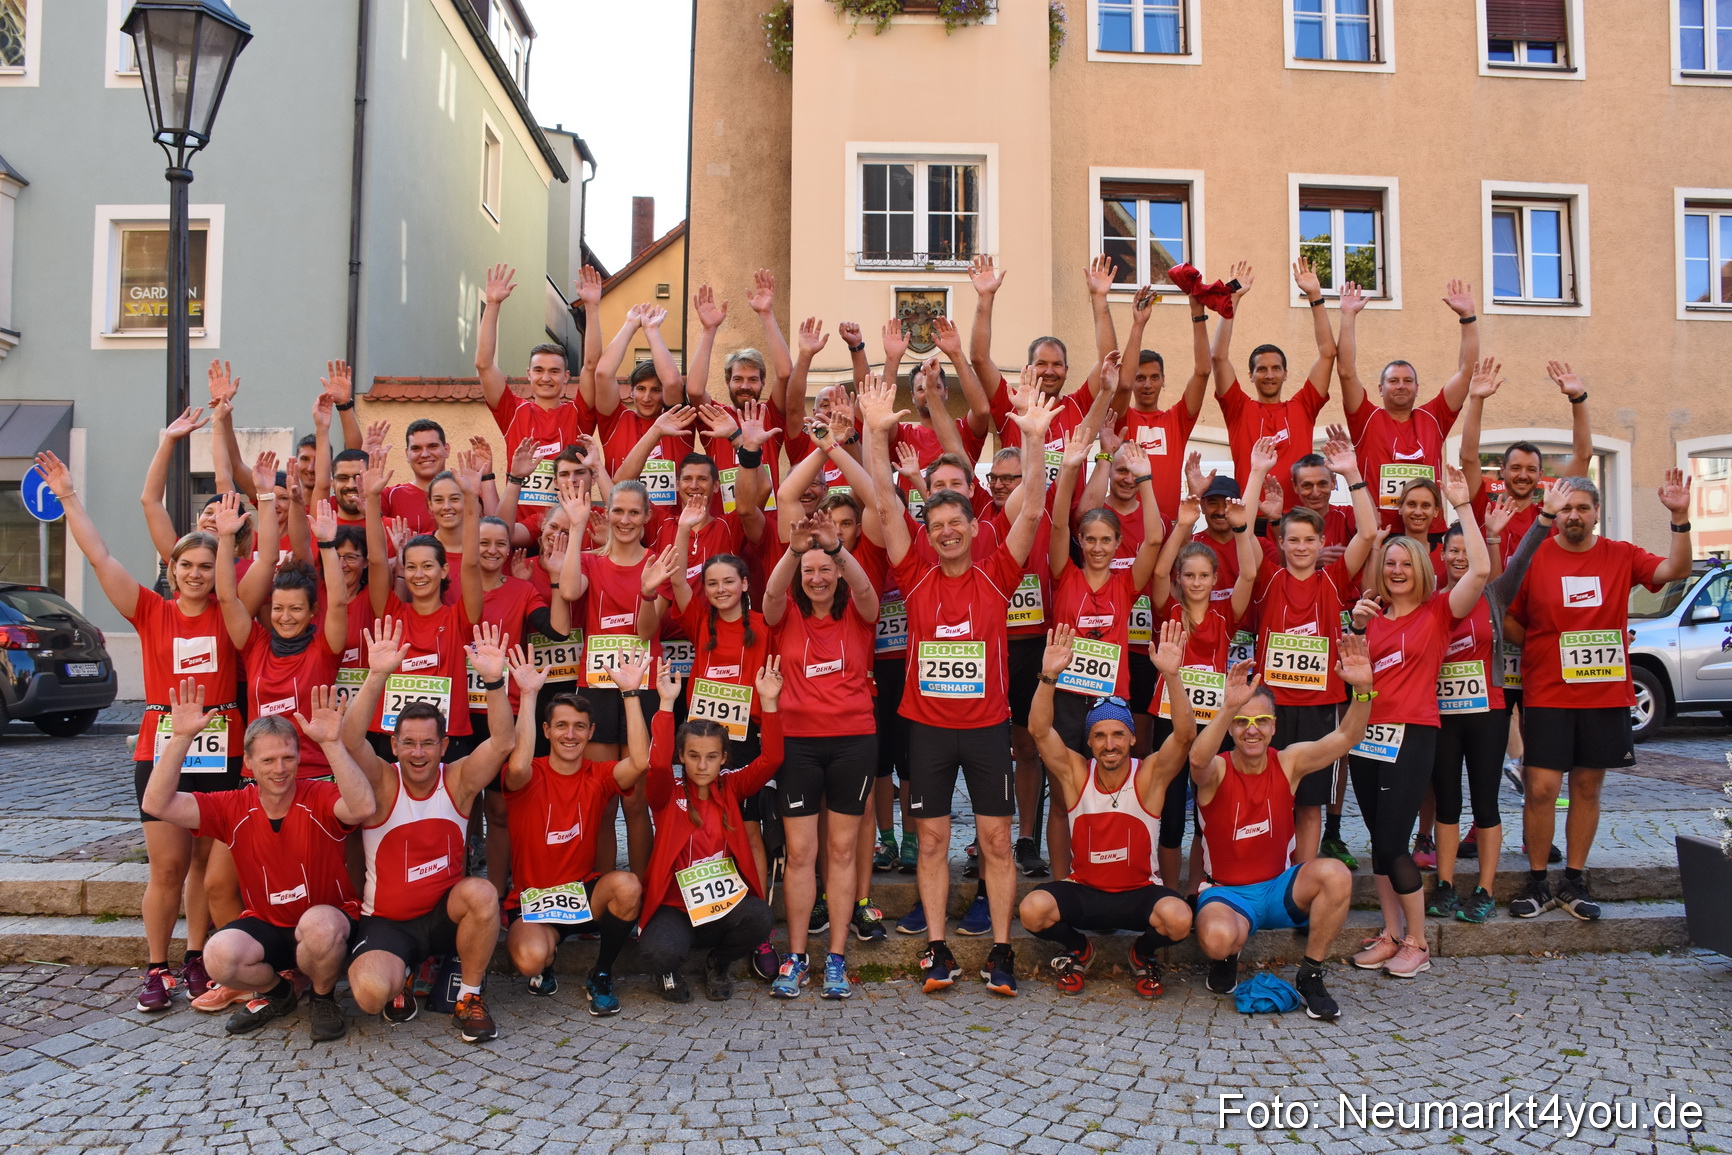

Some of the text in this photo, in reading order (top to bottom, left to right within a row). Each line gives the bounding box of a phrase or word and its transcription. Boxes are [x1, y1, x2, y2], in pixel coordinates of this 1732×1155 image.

[1384, 466, 1433, 479] BOCK
[520, 474, 560, 491] 257
[638, 474, 670, 489] 579
[524, 492, 559, 502] PATRICK
[610, 616, 625, 625] DEHN
[1007, 612, 1031, 620] BERT
[878, 617, 908, 635] 257
[592, 637, 644, 650] BOCK
[888, 637, 908, 645] SAR
[1272, 635, 1323, 651] BOCK
[1564, 632, 1619, 646] BOCK
[534, 647, 577, 666] 5181
[924, 644, 979, 656] BOCK
[1569, 648, 1617, 665] 1317
[411, 659, 428, 667] DEHN
[1272, 652, 1321, 671] 5184
[816, 665, 833, 673] DEHN
[926, 661, 978, 678] 2569
[1440, 662, 1478, 677] OCK
[1576, 668, 1611, 677] MARTIN
[390, 676, 445, 692] BOCK
[1063, 675, 1104, 690] CARMEN
[1181, 670, 1220, 687] OCK
[1271, 672, 1320, 683] SEBASTIAN
[698, 681, 746, 701] BOCK
[928, 683, 976, 692] GERHARD
[269, 703, 286, 712] DEHN
[695, 699, 741, 721] 5191
[1441, 700, 1473, 708] STEFFI
[1366, 724, 1396, 743] 557
[1245, 827, 1261, 835] DEHN
[419, 863, 438, 875] DEHN
[682, 860, 733, 885] BOCK
[280, 892, 297, 901] DEHN
[690, 878, 739, 904] 5192
[530, 894, 581, 912] 2586
[710, 901, 733, 914] JOLA
[537, 911, 577, 919] STEFAN
